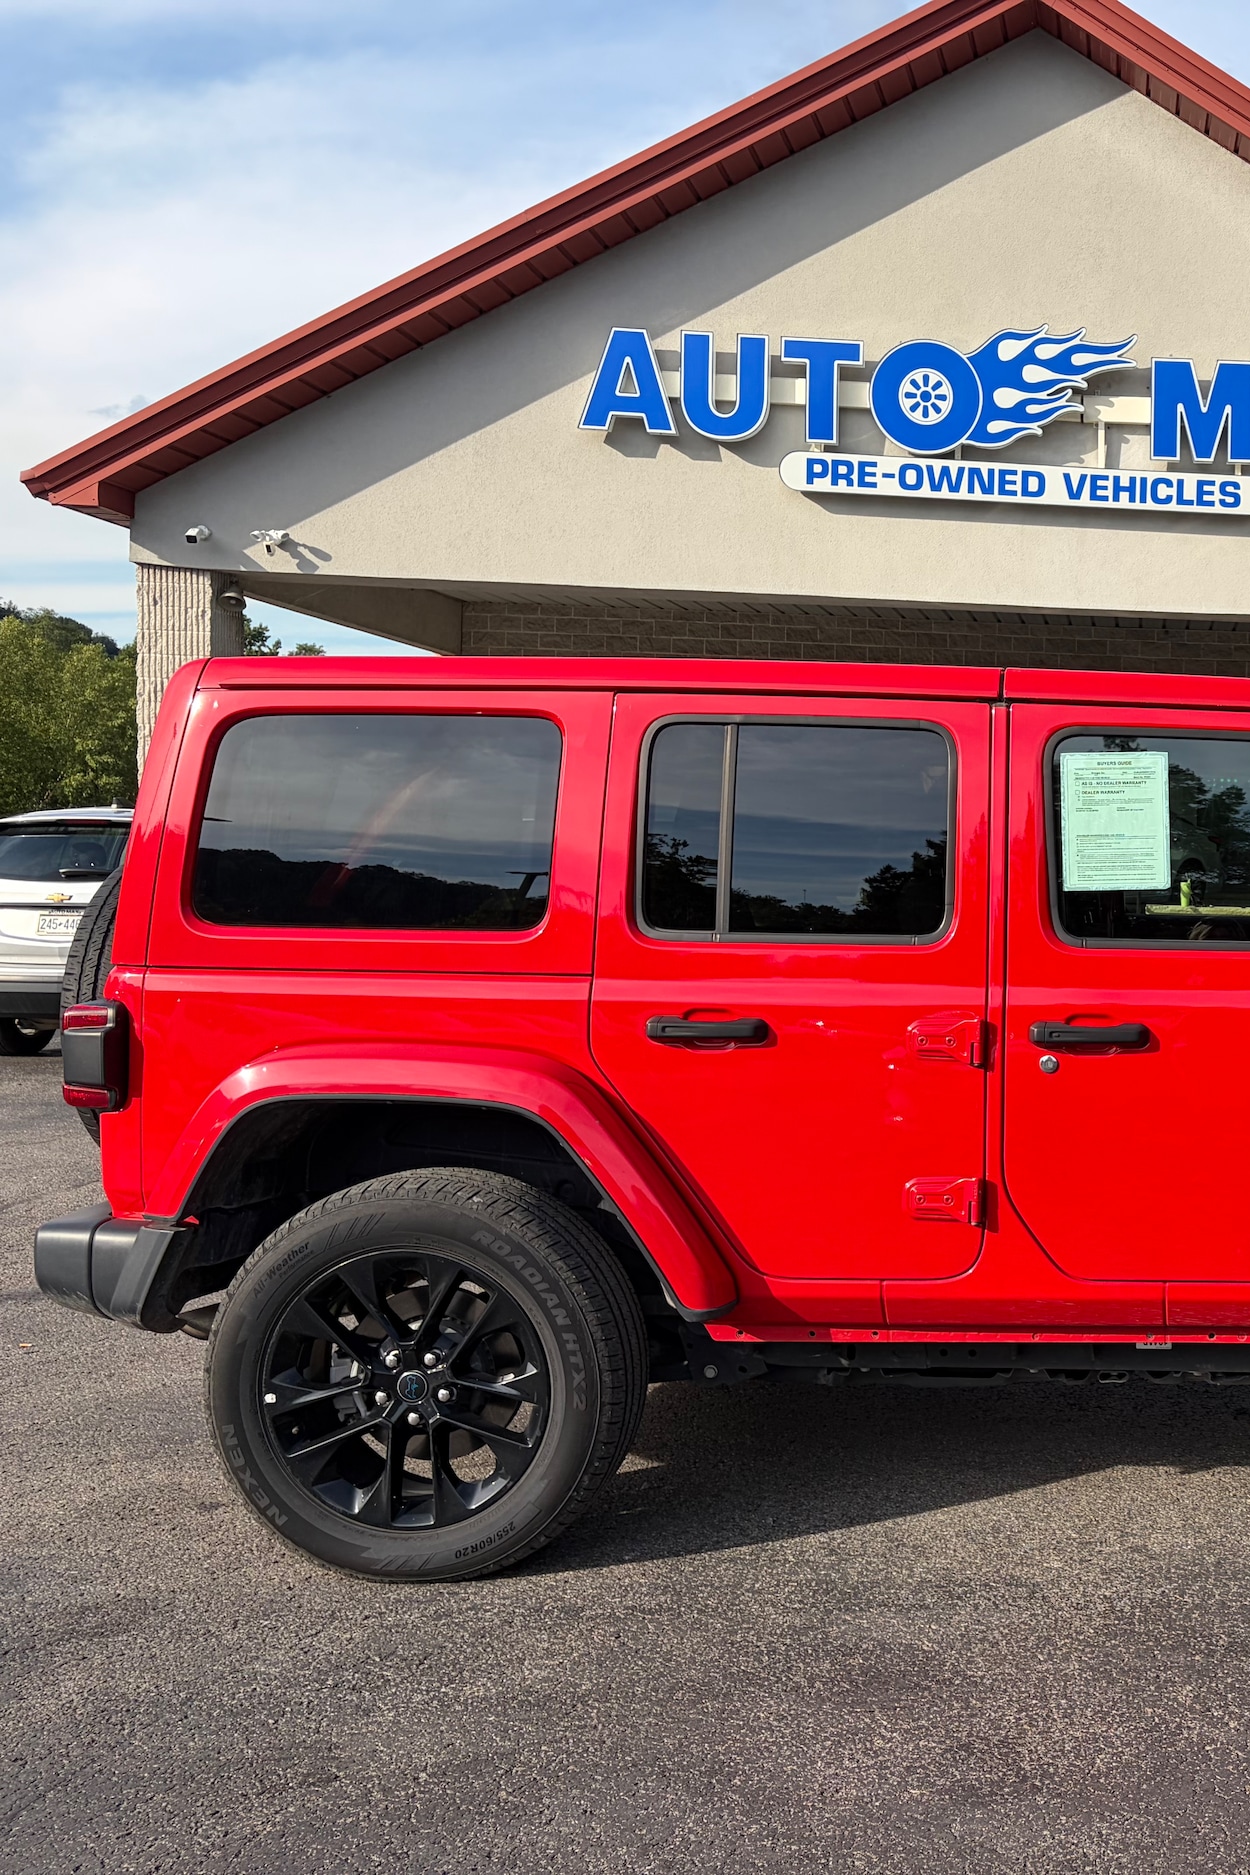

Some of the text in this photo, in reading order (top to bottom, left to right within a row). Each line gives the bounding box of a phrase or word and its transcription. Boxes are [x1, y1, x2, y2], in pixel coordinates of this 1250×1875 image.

[578, 326, 984, 455] AUTO
[806, 457, 1241, 508] PRE-OWNED VEHICLES
[252, 1241, 310, 1299] All-Weather
[471, 1230, 587, 1411] ROADIAN HTX2
[222, 1424, 289, 1527] NEXEN
[455, 1521, 516, 1559] 255/60R20
